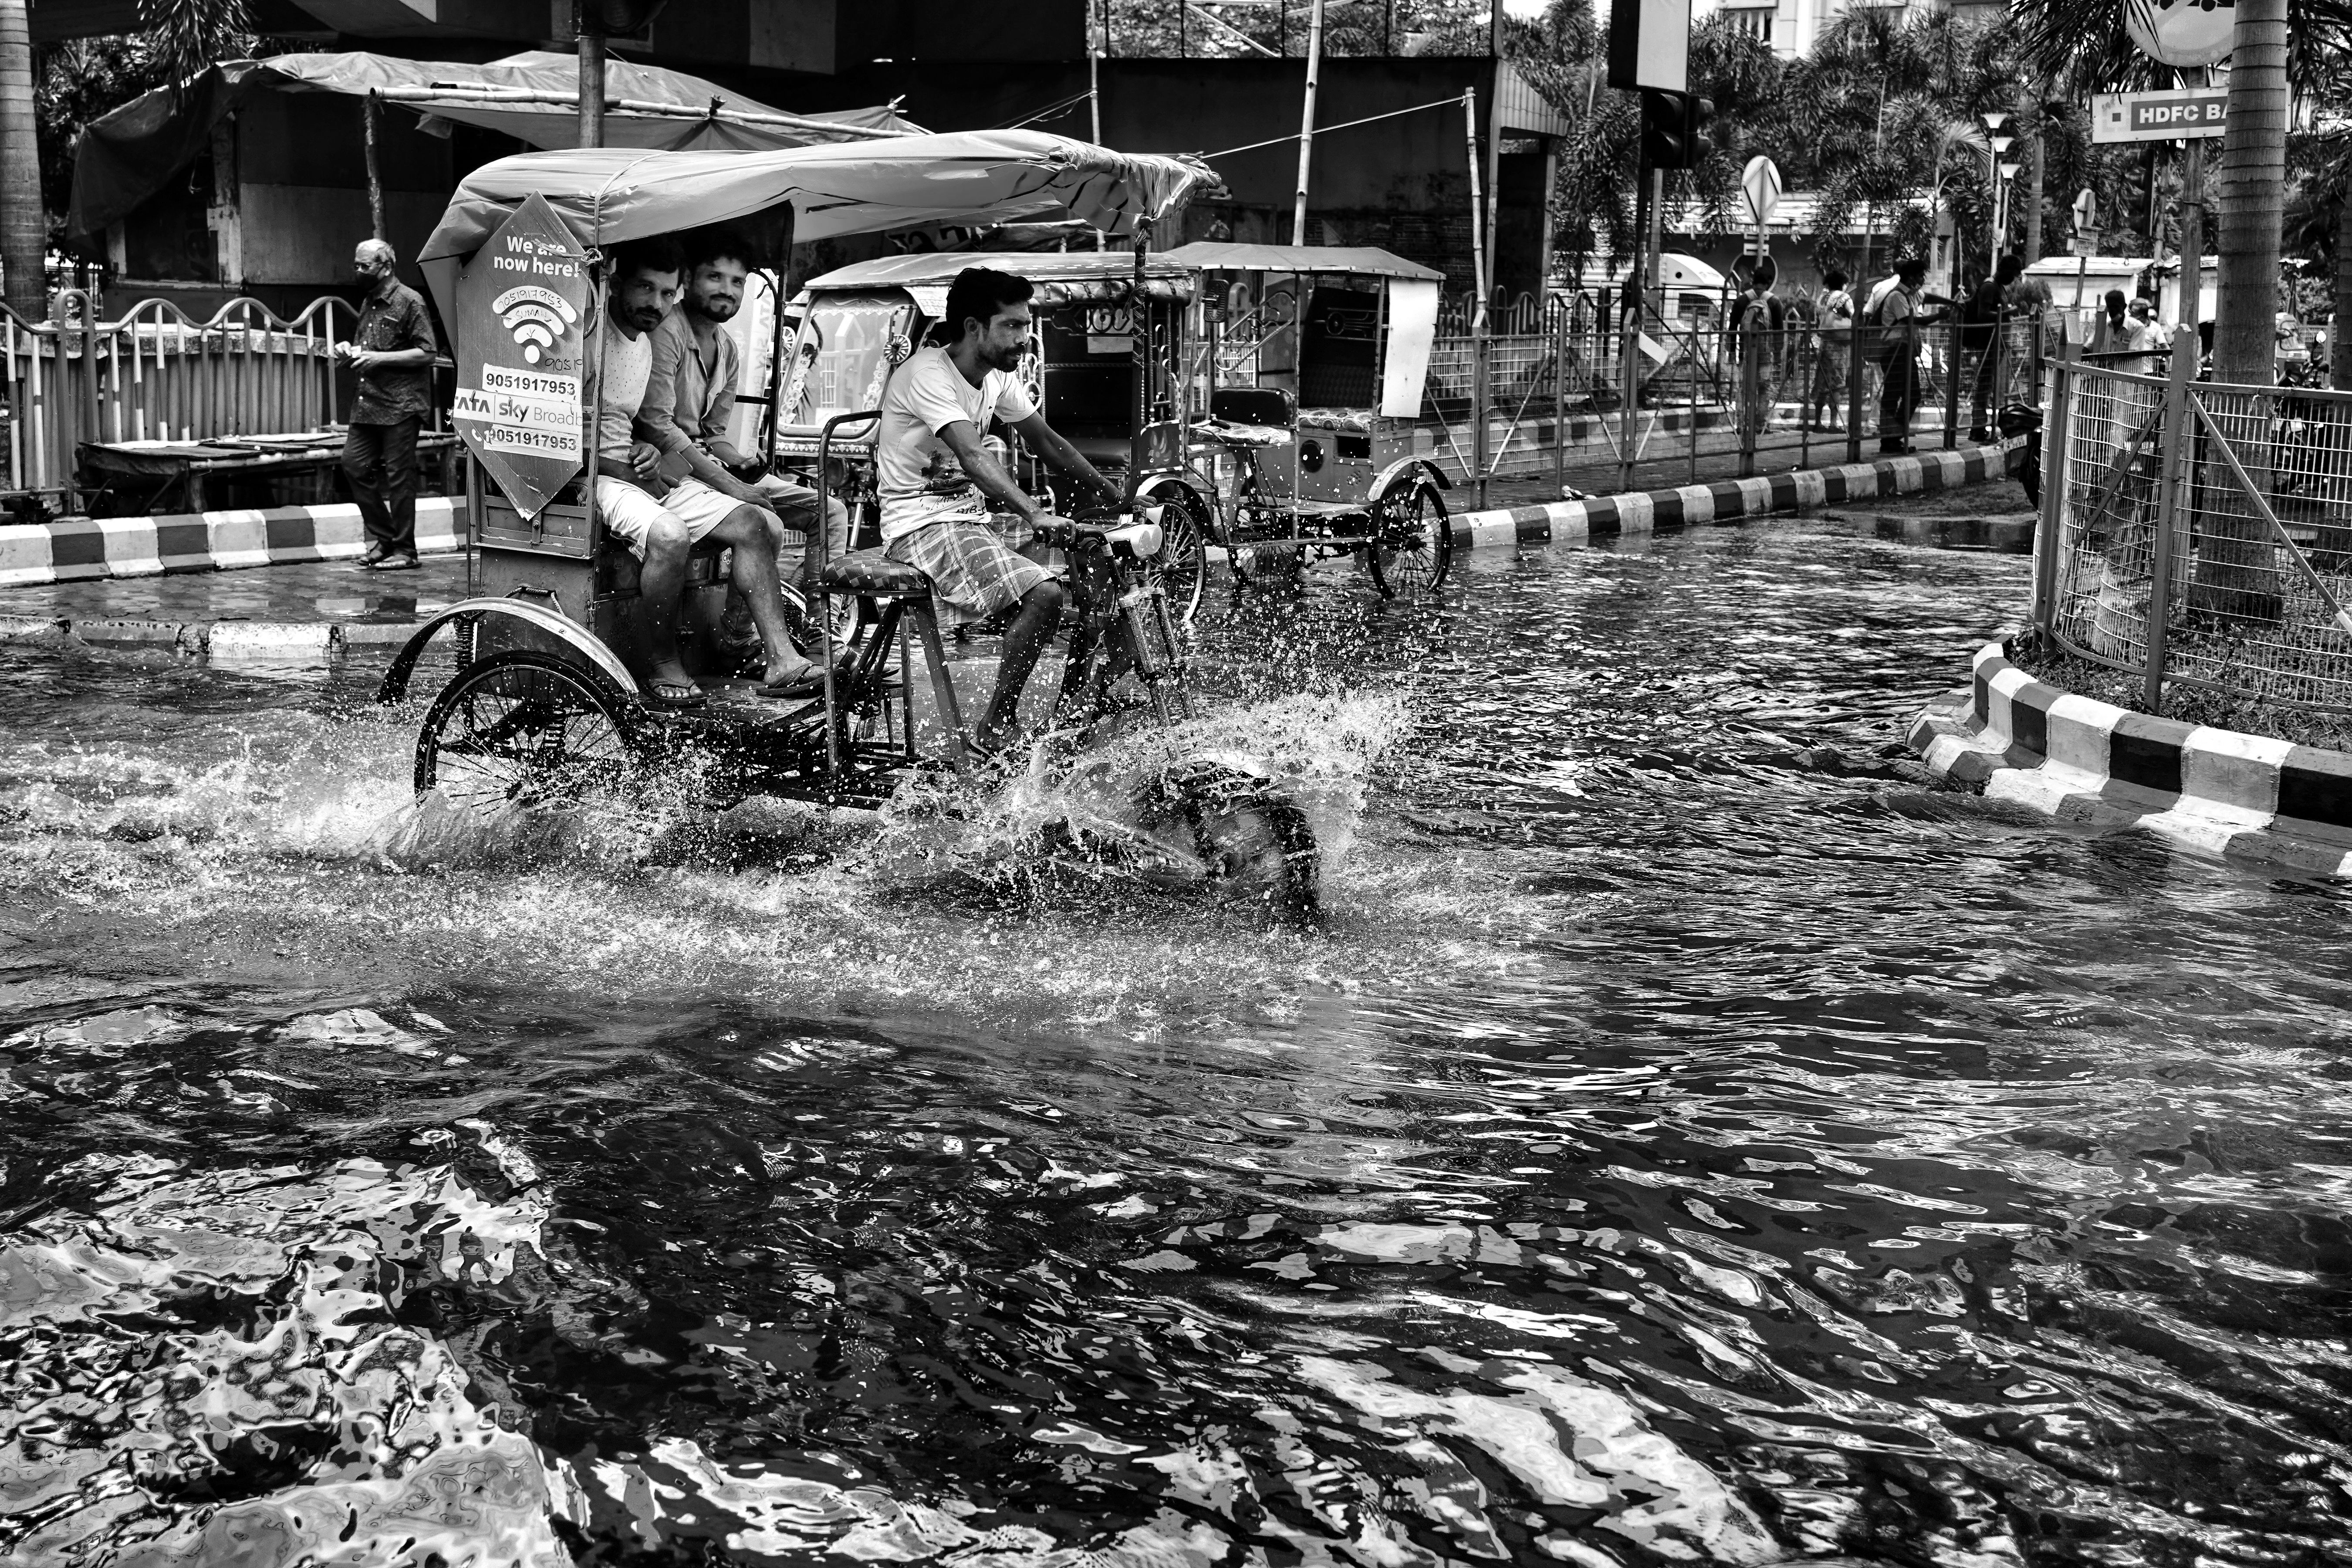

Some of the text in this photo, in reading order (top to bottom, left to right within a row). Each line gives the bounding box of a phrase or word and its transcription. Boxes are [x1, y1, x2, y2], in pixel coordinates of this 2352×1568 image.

[2139, 105, 2199, 124] HDFC
[506, 235, 533, 254] We
[493, 256, 579, 278] now here!
[486, 373, 575, 395] 9051917953
[455, 396, 491, 414] ATA
[499, 398, 530, 422] sky
[489, 428, 577, 451] 9051917953
